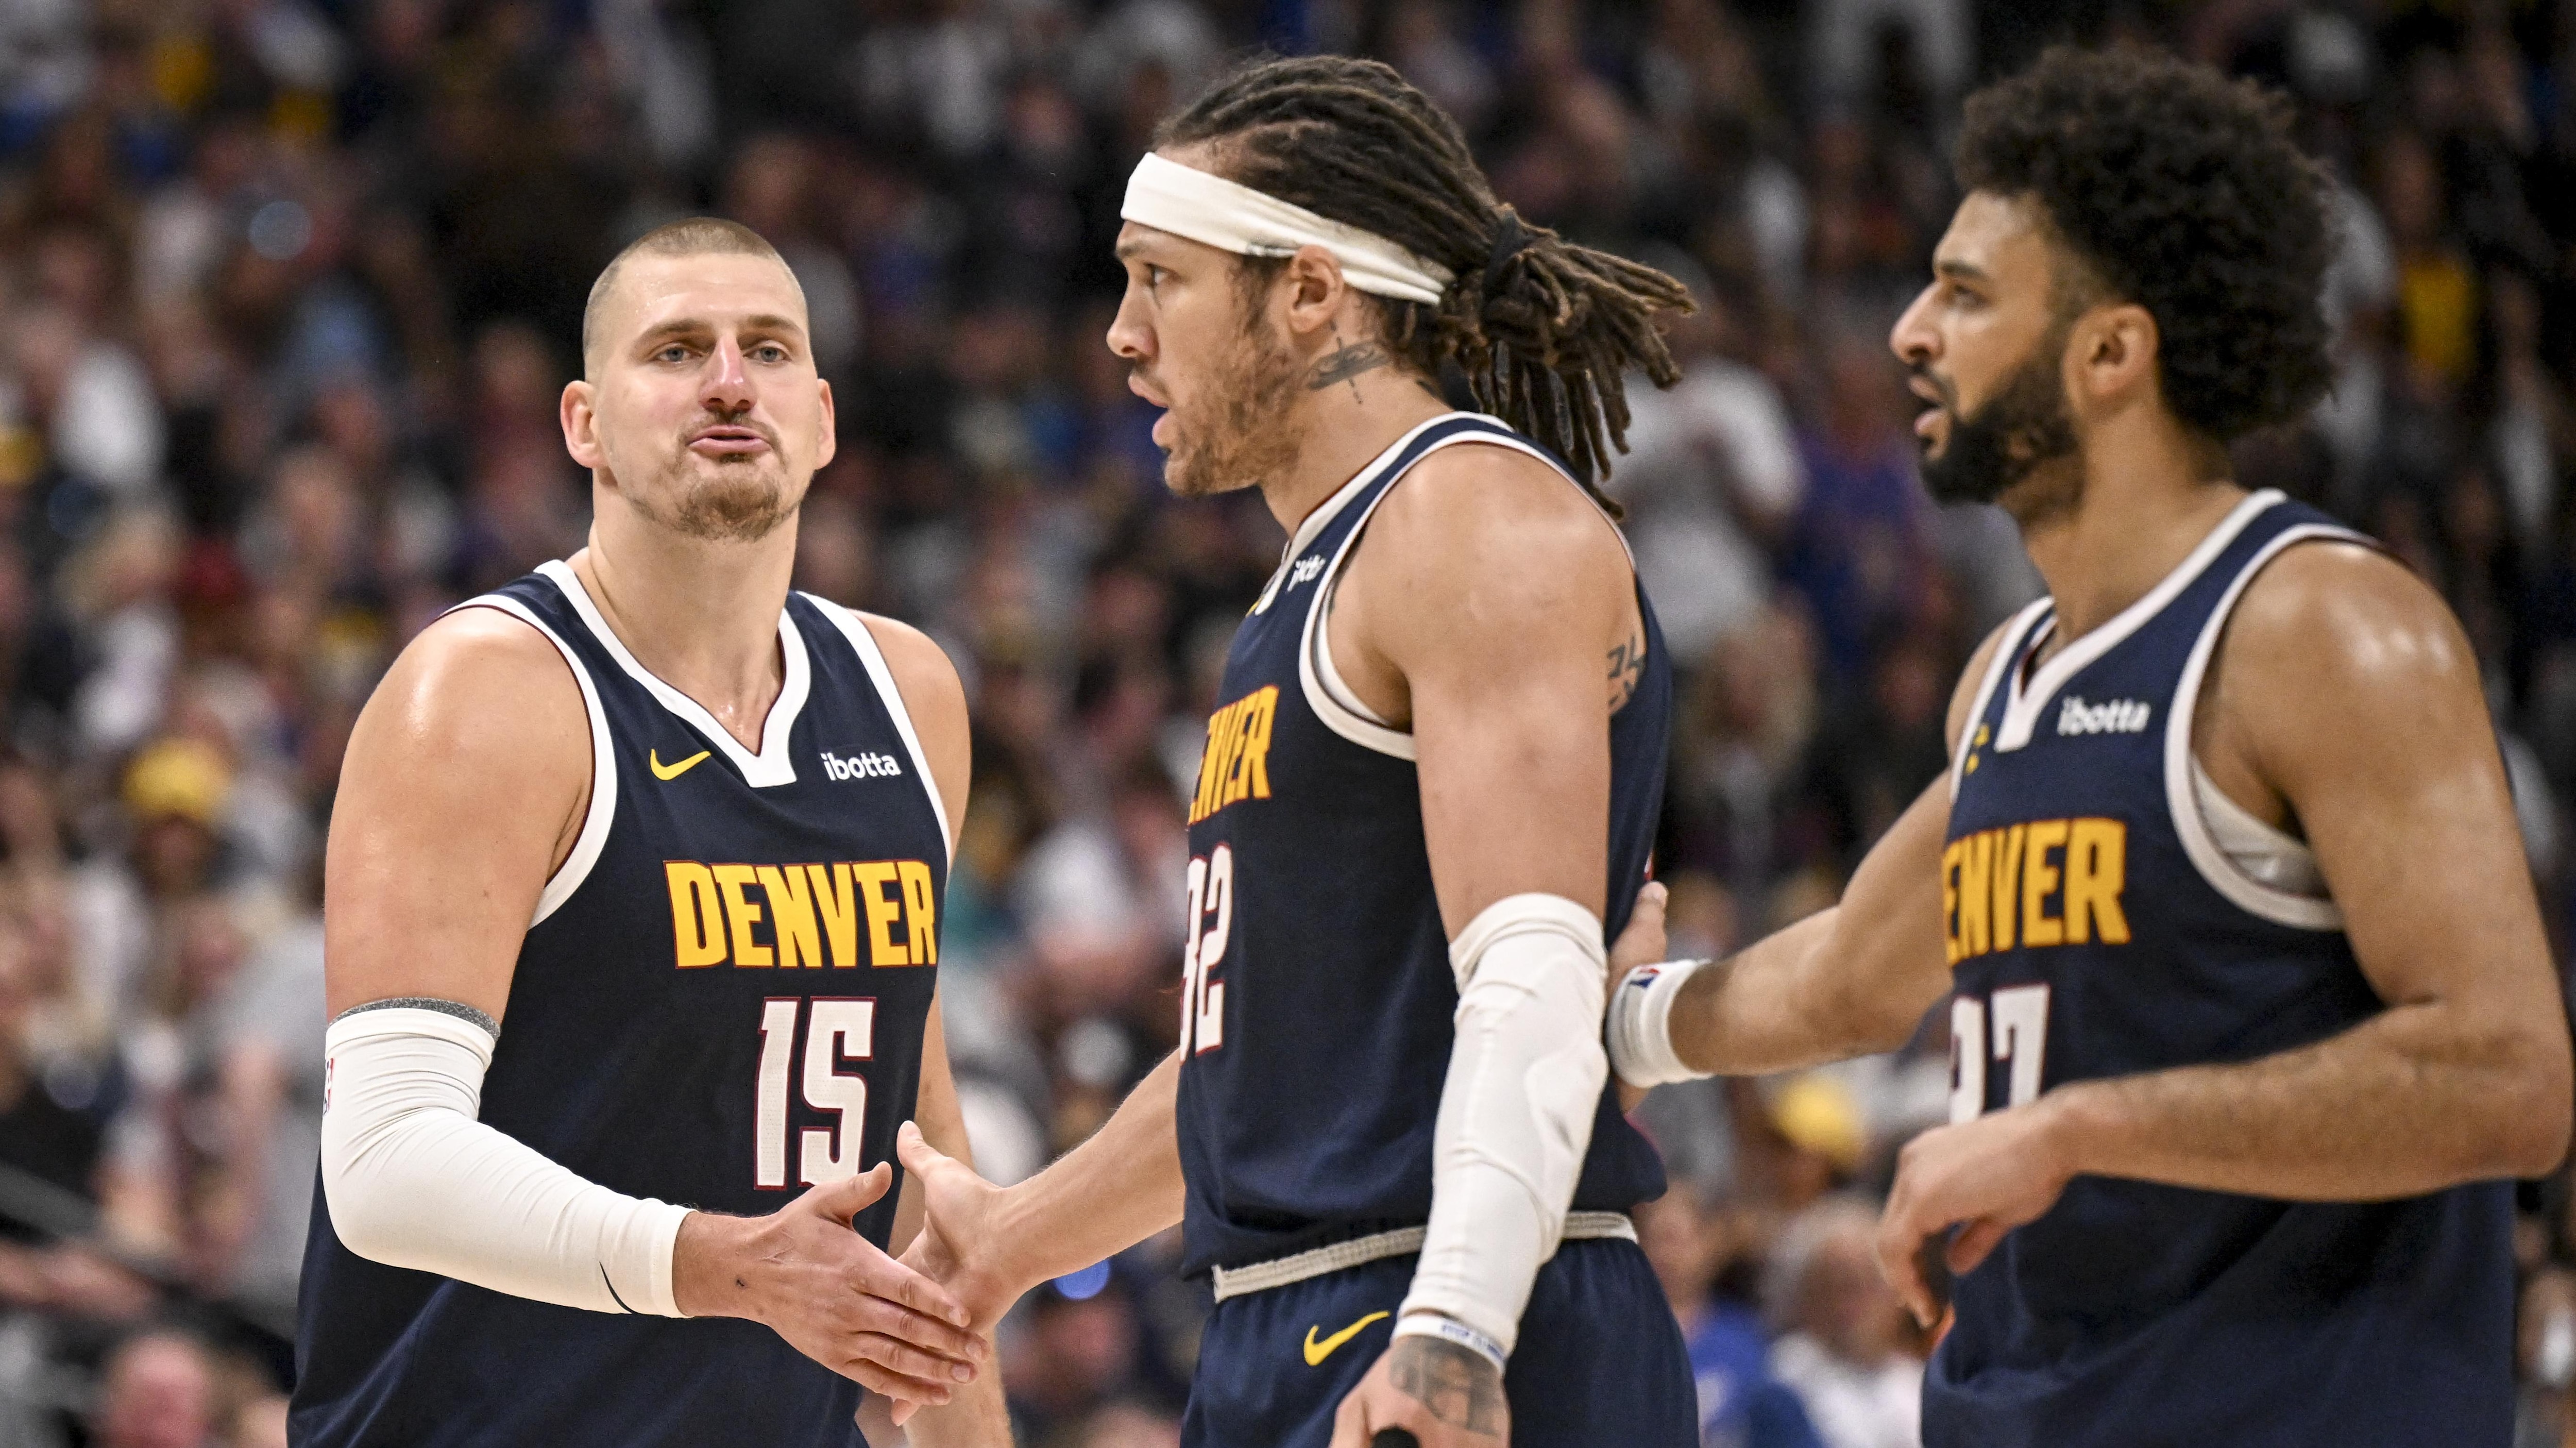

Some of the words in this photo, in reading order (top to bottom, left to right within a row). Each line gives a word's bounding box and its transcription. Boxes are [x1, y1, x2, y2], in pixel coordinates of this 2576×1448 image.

[820, 752, 902, 781] ibotta
[663, 860, 937, 969] DENVER
[1942, 817, 2131, 967] ENVER
[754, 996, 877, 1190] 15
